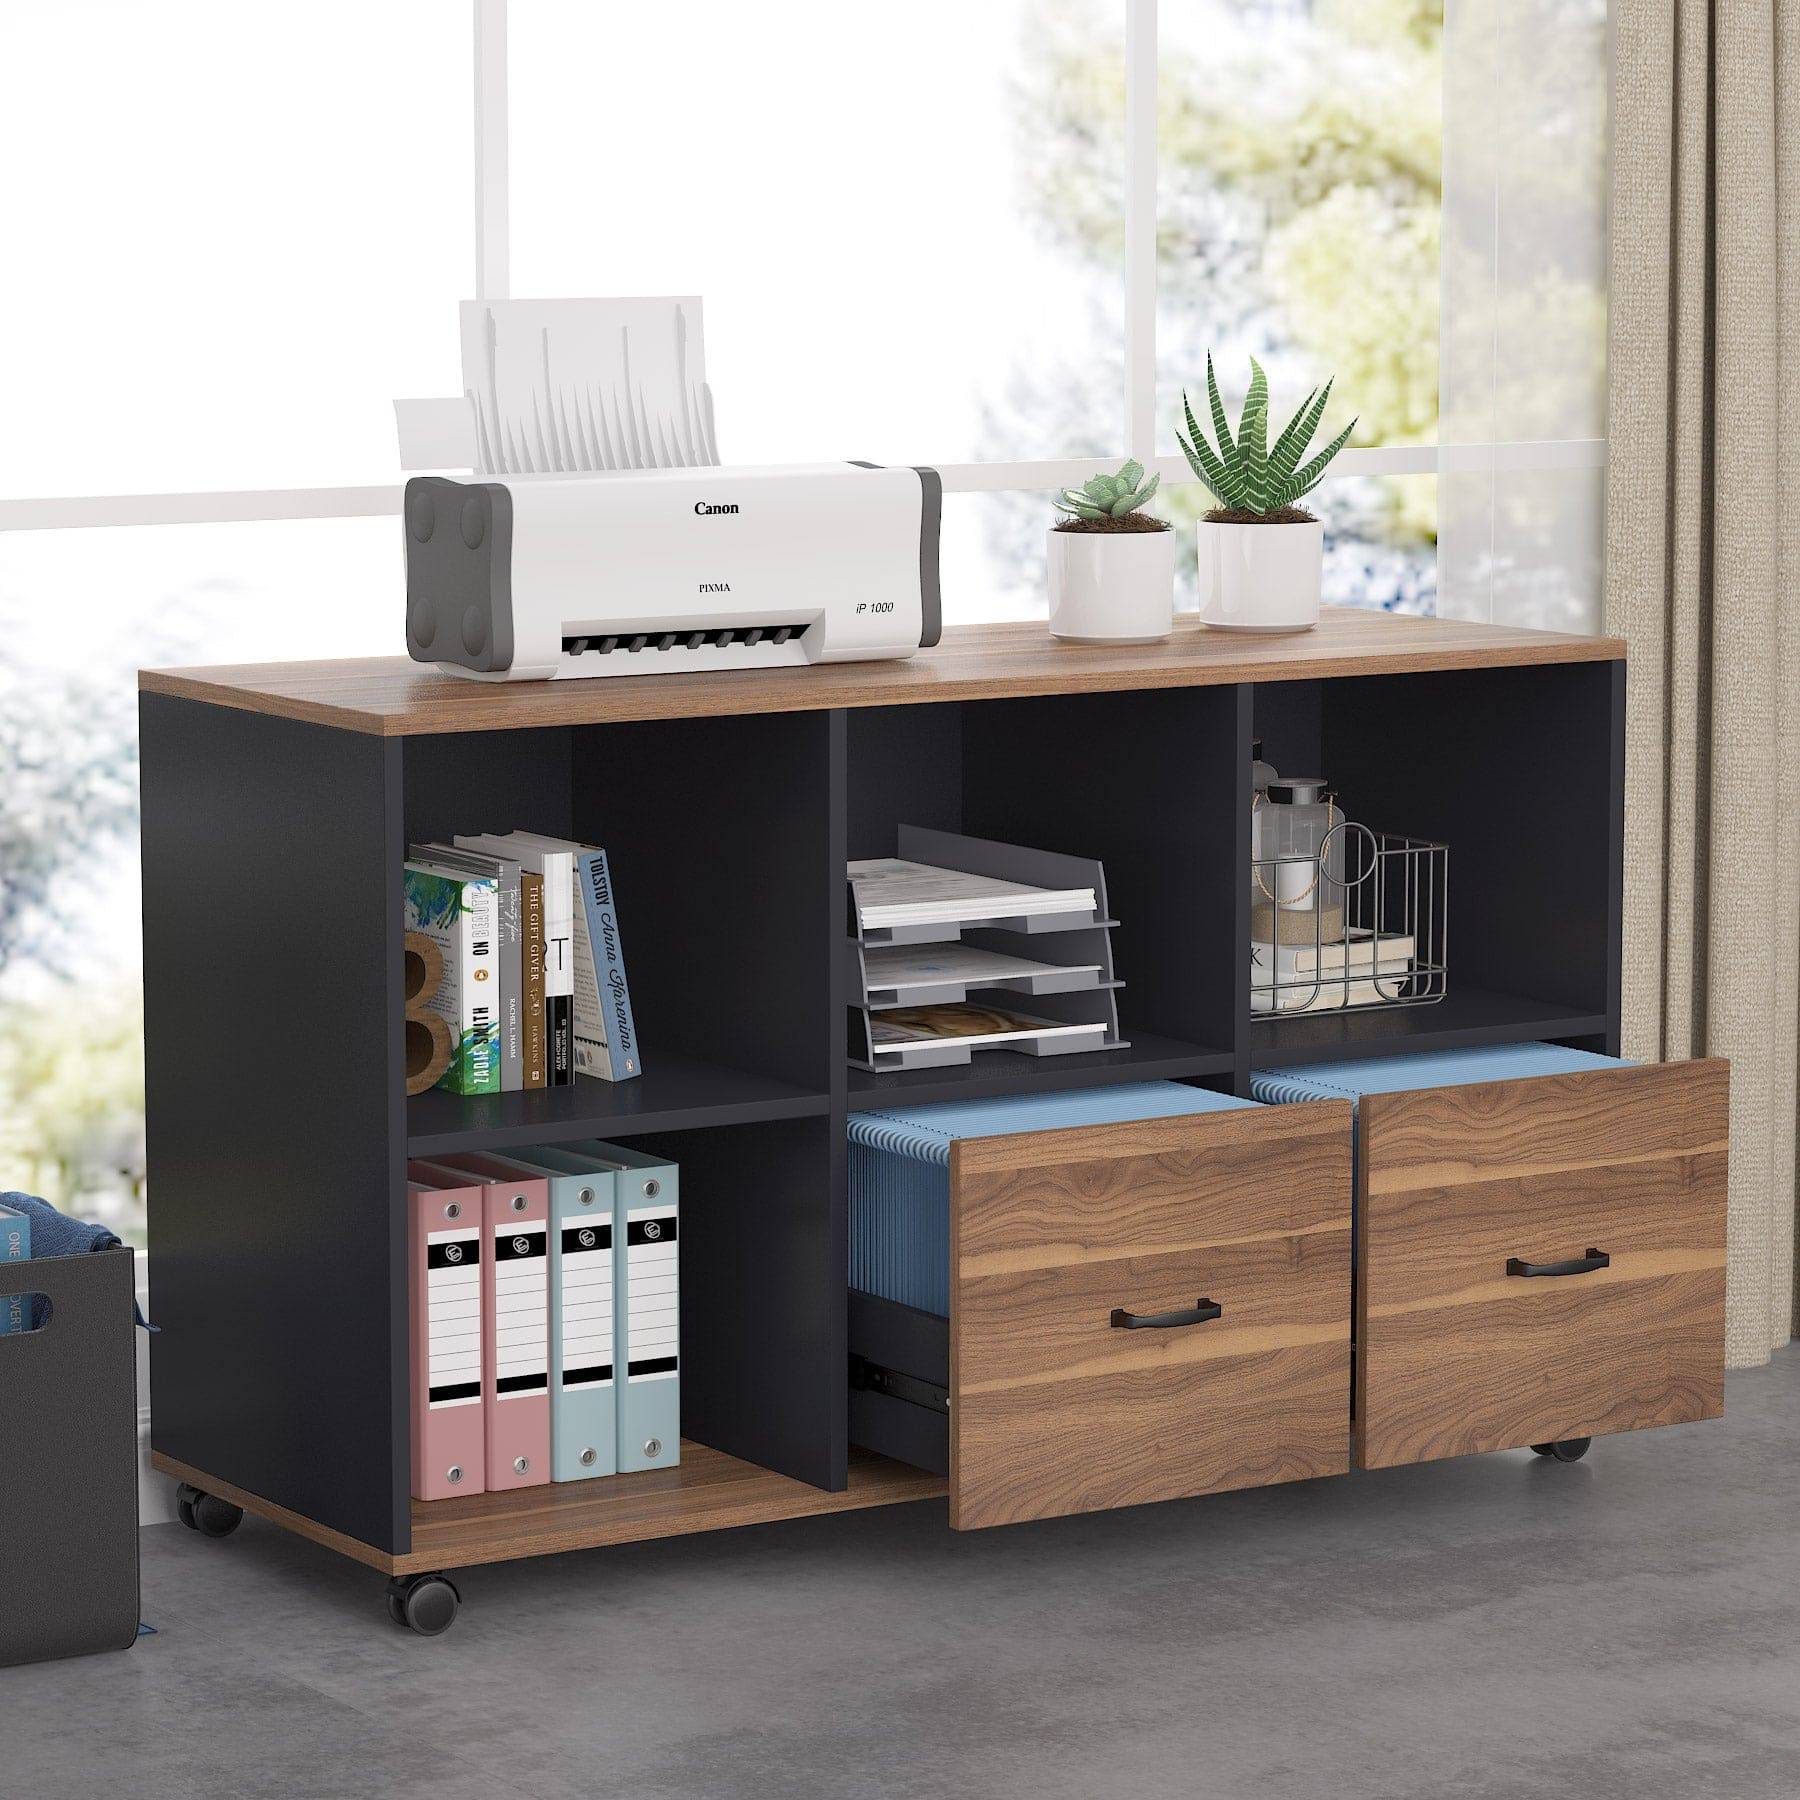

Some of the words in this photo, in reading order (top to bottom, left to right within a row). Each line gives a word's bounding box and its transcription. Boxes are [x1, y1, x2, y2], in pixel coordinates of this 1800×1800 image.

[694, 501, 740, 515] Canon
[699, 583, 731, 593] PIXMA
[856, 603, 867, 614] iP
[870, 602, 894, 613] 1000
[529, 885, 539, 910] THE
[589, 855, 610, 906] TOLSTOY
[471, 892, 490, 938] BEAUTY
[530, 913, 539, 941] GIFT
[472, 941, 489, 956] ON
[601, 913, 616, 964] Anna
[530, 944, 540, 981] GIVER
[472, 1007, 489, 1045] SMITH
[607, 968, 631, 1053] Karenina
[531, 1025, 539, 1064] HAWKINS
[473, 1049, 490, 1085] ZADIE
[8, 1231, 20, 1257] ONE
